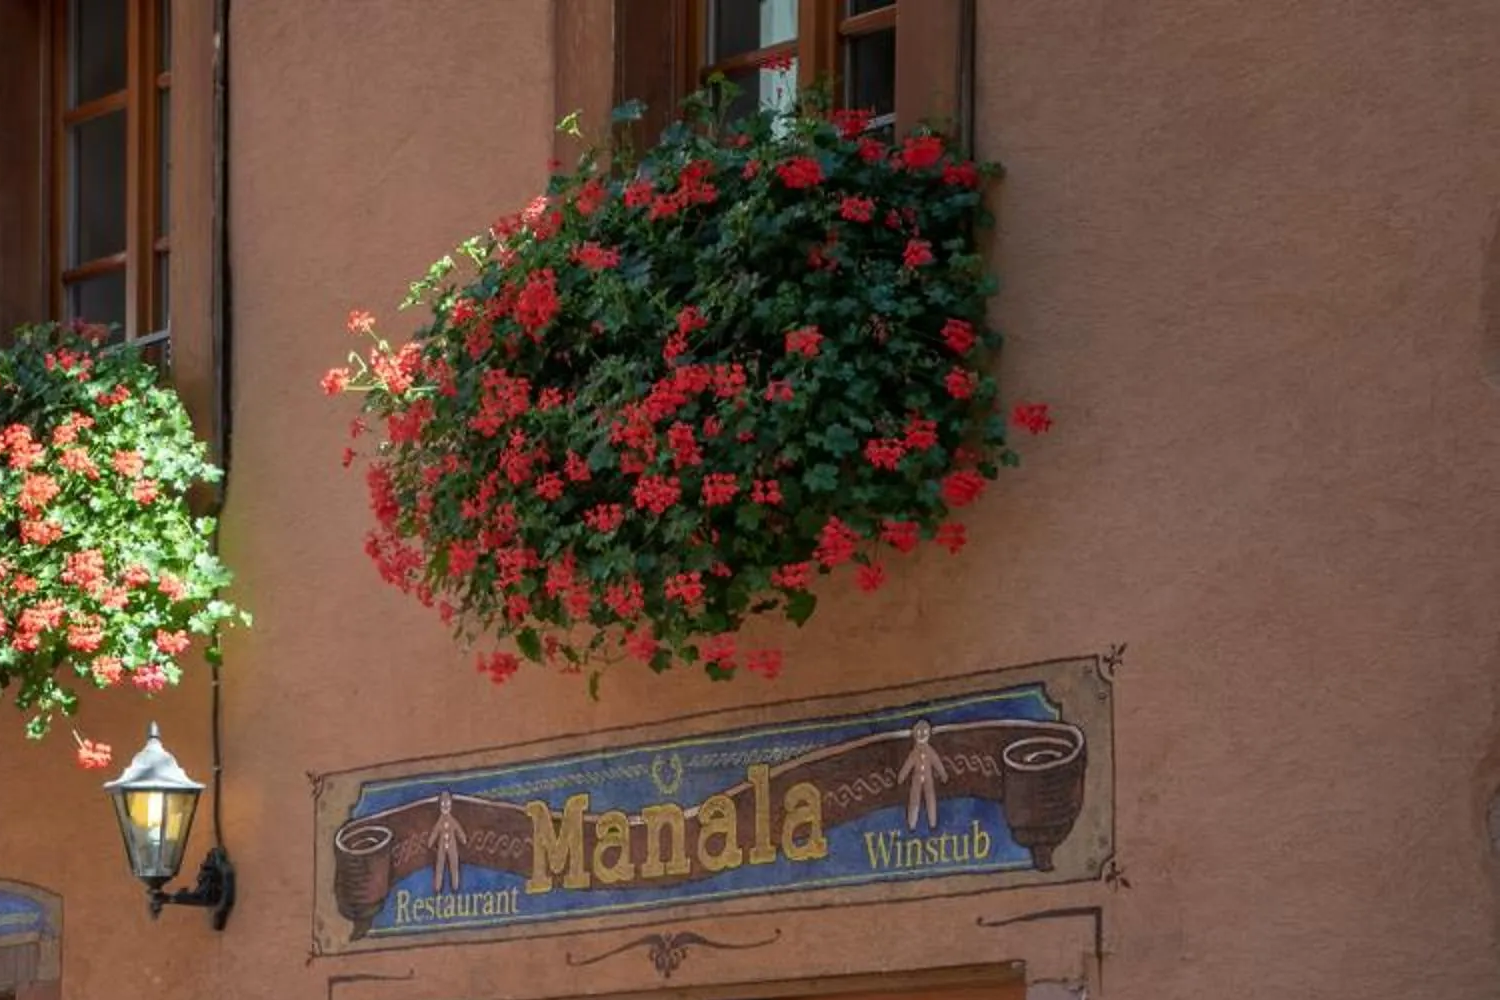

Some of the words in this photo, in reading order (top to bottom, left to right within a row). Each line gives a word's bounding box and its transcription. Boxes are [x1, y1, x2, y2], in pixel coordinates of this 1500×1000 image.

[524, 763, 828, 894] Manala
[863, 820, 991, 869] Winstub
[396, 886, 519, 923] Restaurant
